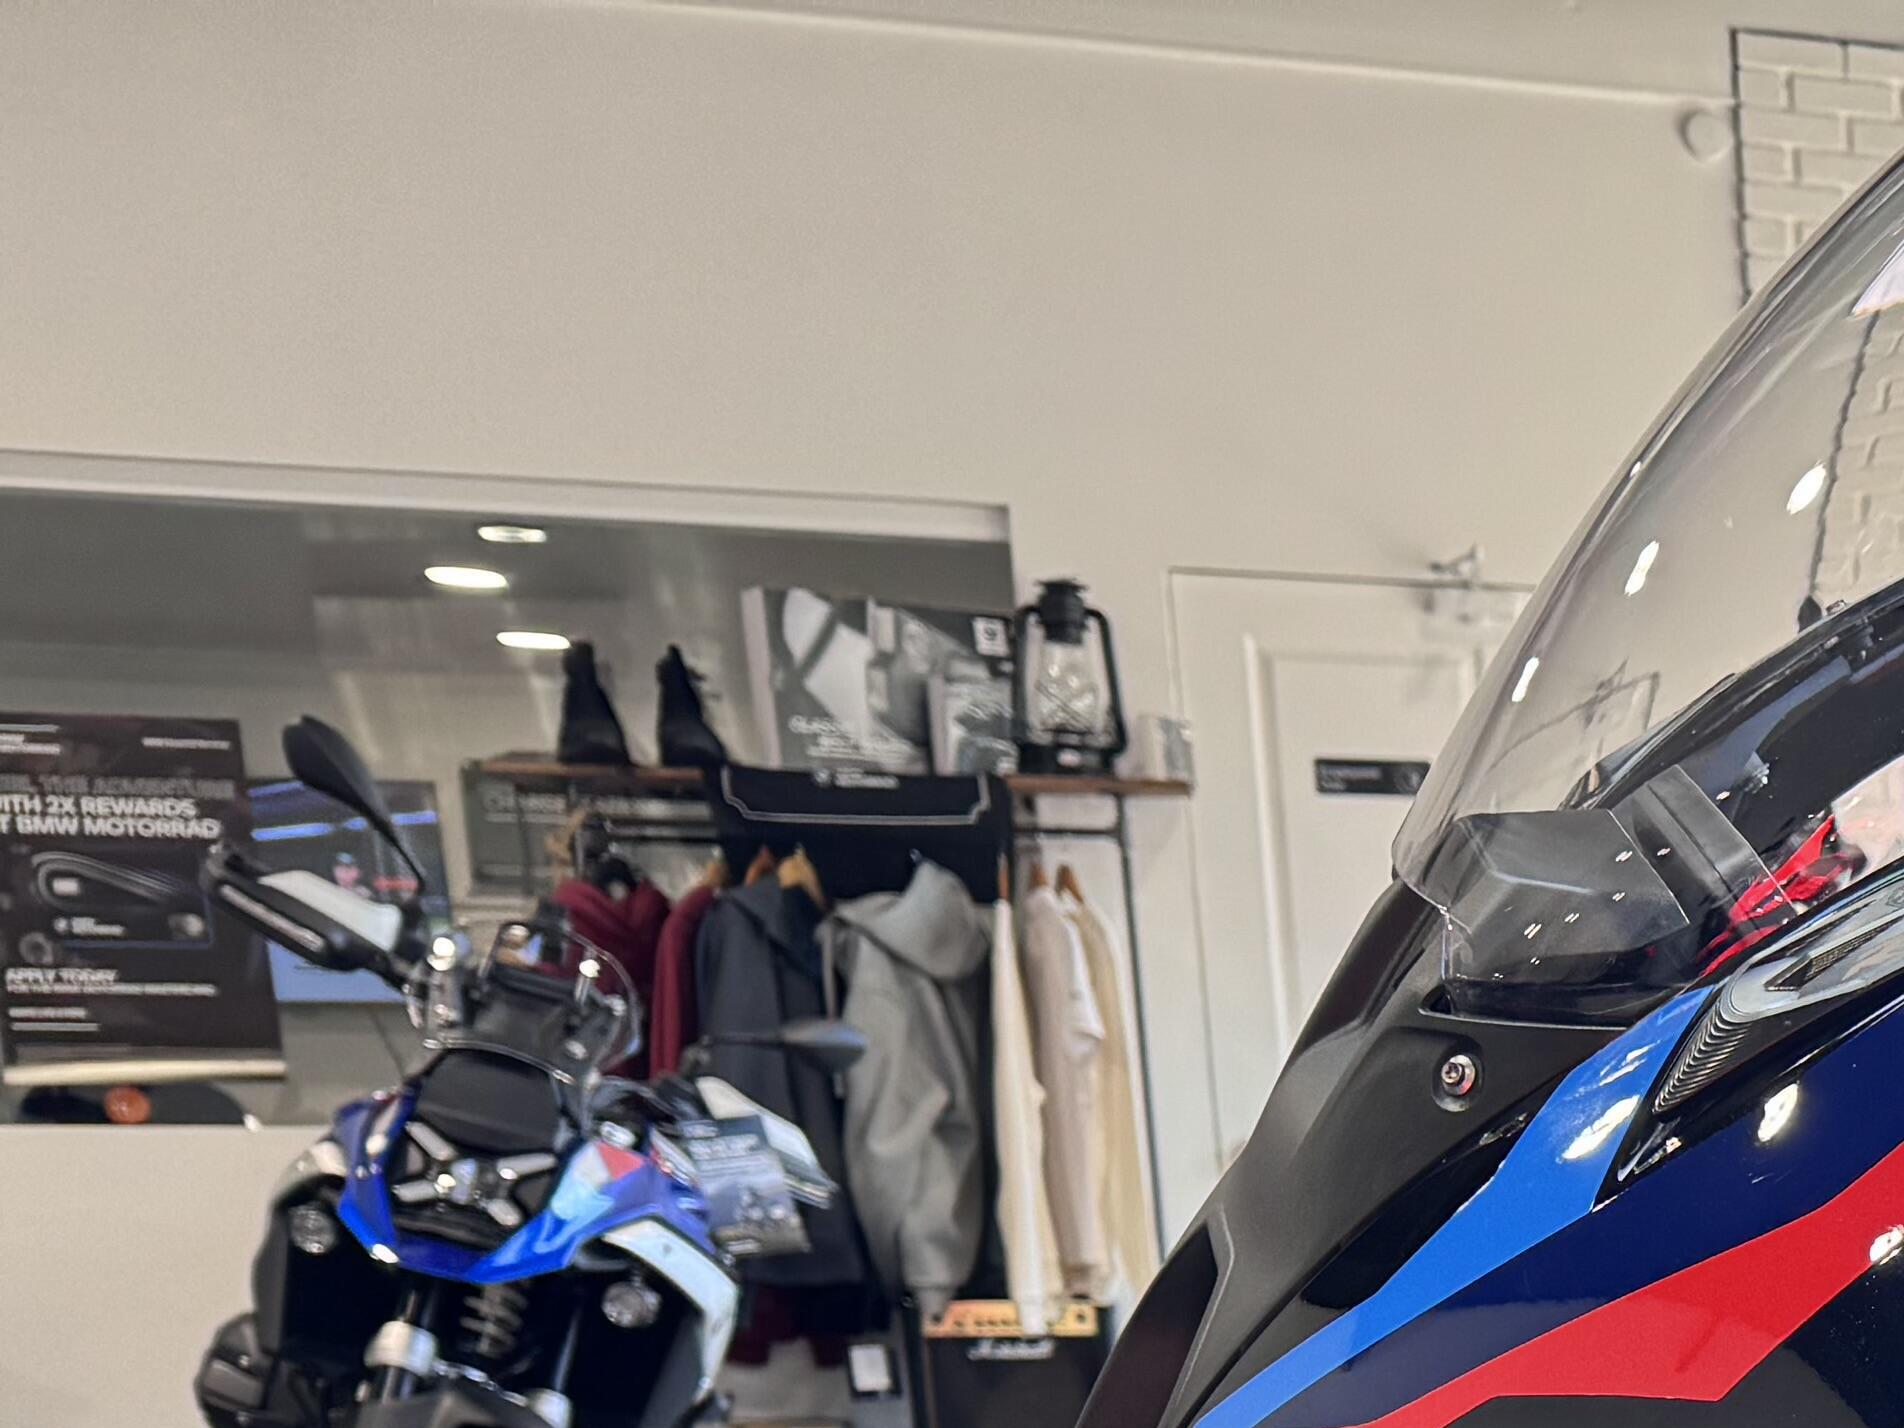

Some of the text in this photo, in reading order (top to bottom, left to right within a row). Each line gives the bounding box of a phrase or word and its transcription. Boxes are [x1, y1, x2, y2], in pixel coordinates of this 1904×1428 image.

[47, 795, 76, 815] 2X
[80, 796, 197, 818] REWARDS
[16, 815, 79, 836] BMW
[83, 816, 222, 839] MOTORRAD
